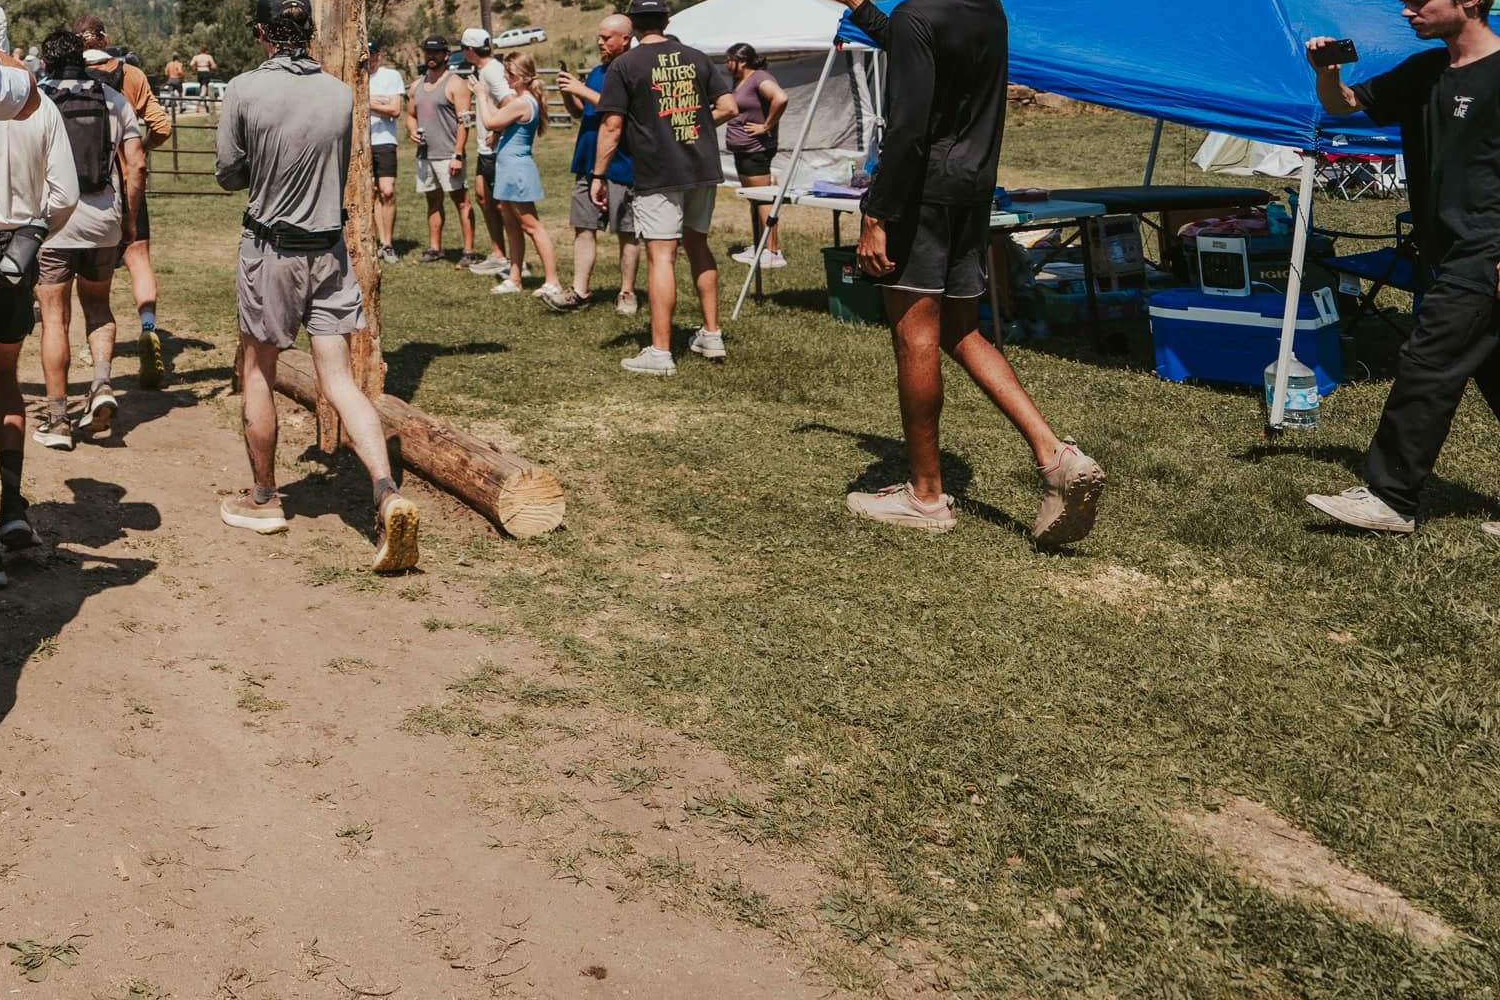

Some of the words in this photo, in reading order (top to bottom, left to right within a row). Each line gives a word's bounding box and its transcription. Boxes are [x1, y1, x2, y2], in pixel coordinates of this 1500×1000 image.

[658, 54, 668, 66] IF
[669, 52, 681, 66] IT
[652, 64, 696, 82] MATTERS
[660, 82, 671, 97] TO
[659, 97, 677, 112] YOU
[678, 94, 699, 108] WILL
[672, 111, 697, 126] MAKE
